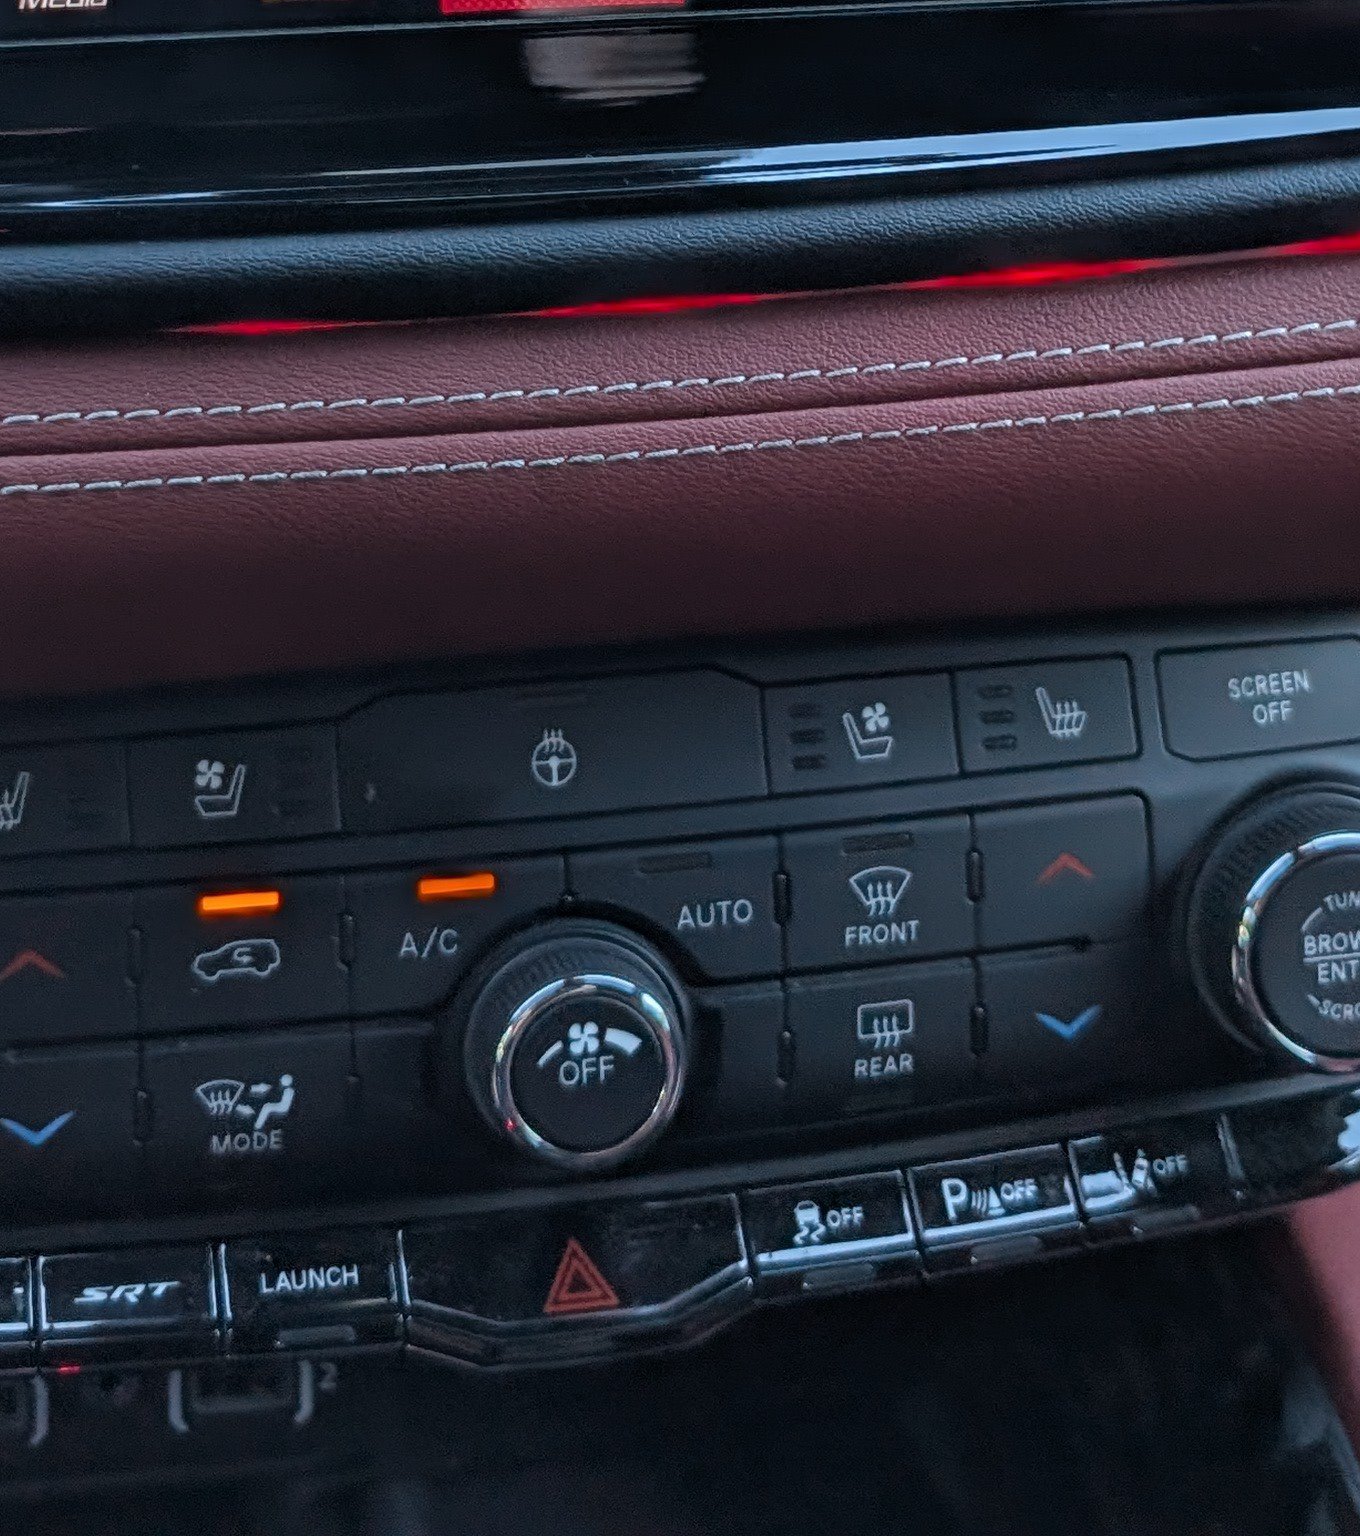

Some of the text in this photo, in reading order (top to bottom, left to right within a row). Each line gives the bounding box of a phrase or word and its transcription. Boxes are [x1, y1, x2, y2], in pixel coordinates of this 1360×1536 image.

[1228, 669, 1310, 699] SCREEN
[1252, 700, 1293, 725] OFF
[677, 899, 753, 929] AUTO
[401, 927, 458, 959] A/C
[844, 920, 919, 946] FRONT
[558, 1055, 615, 1085] OFF
[854, 1053, 914, 1078] REAR
[211, 1129, 283, 1153] MODE
[1153, 1154, 1189, 1177] OFF
[941, 1178, 1039, 1221] P OFF
[826, 1205, 866, 1231] OFF
[74, 1280, 183, 1304] SRT
[259, 1263, 360, 1295] LAUNCH
